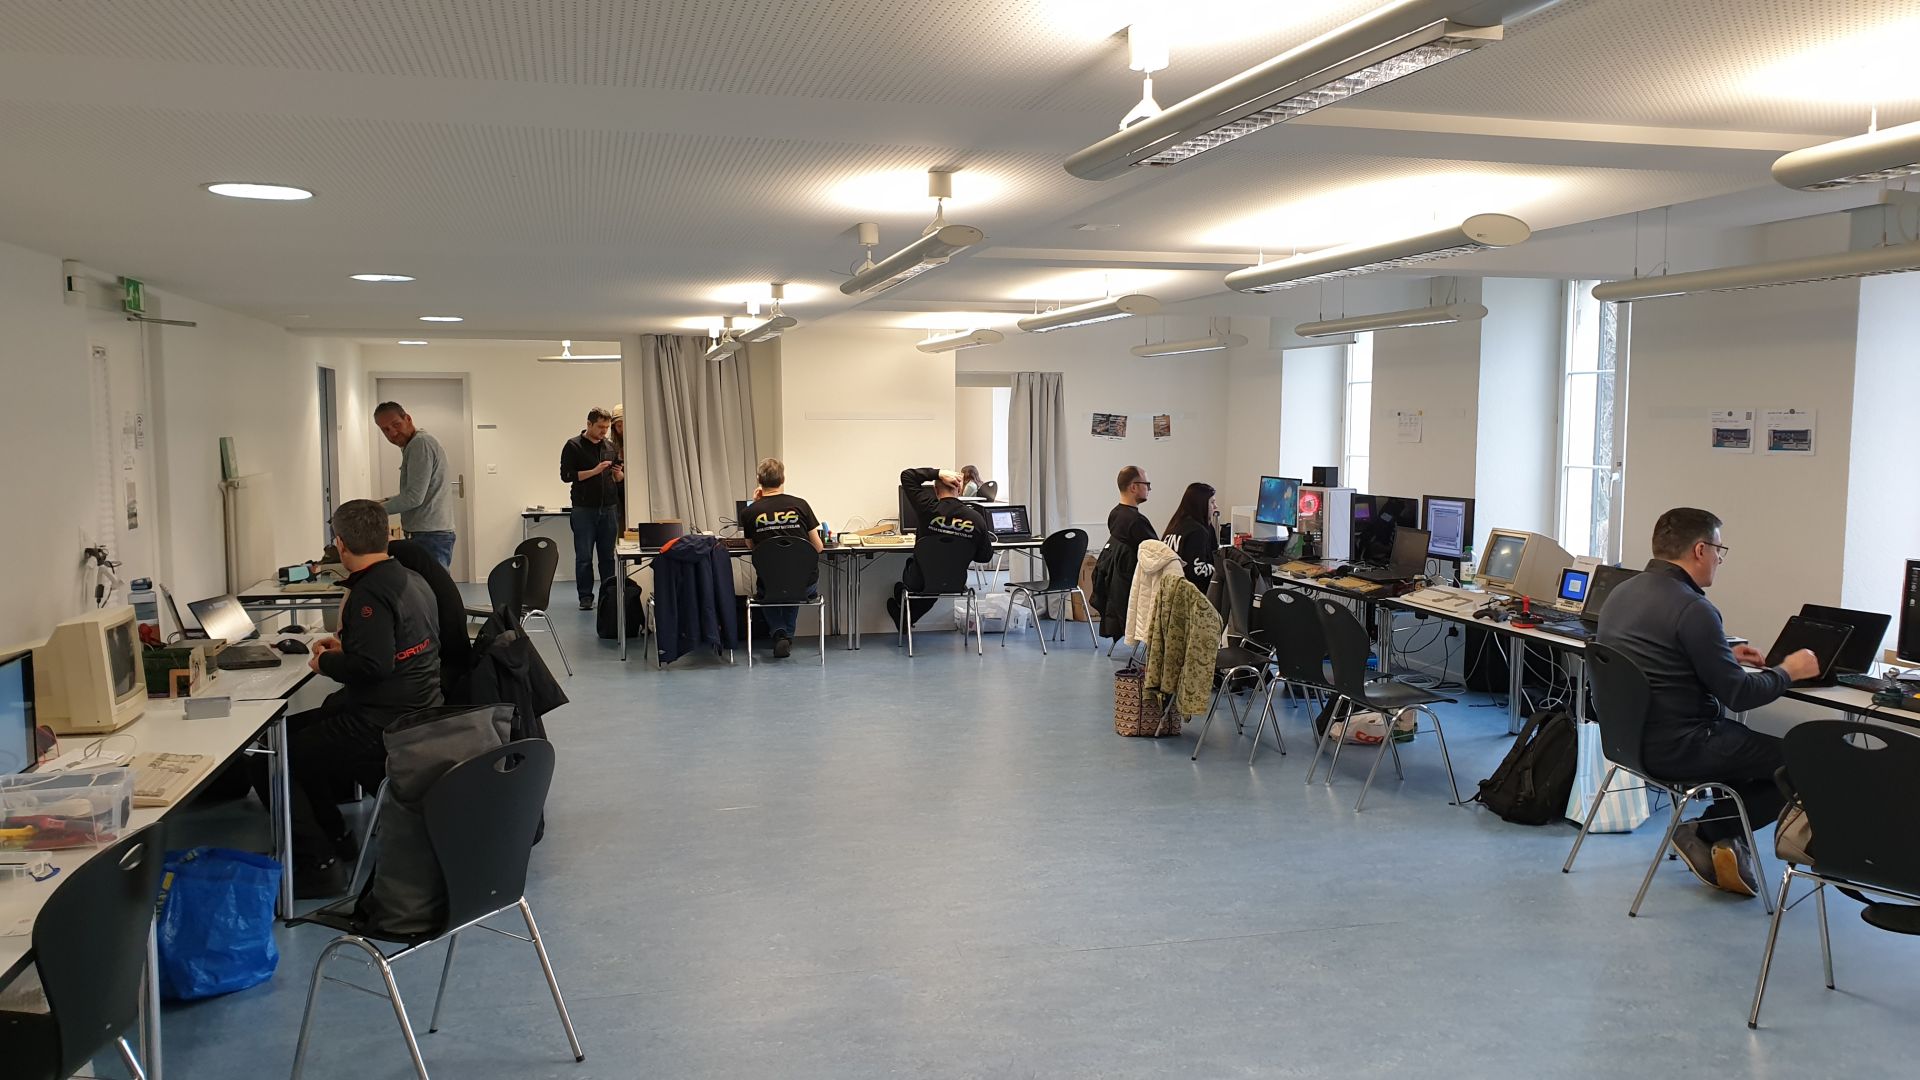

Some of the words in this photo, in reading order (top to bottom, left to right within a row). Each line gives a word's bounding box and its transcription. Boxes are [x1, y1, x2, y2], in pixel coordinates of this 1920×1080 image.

[755, 510, 799, 528] AUGS
[929, 516, 975, 533] AUGS
[395, 638, 430, 660] ORTIV
